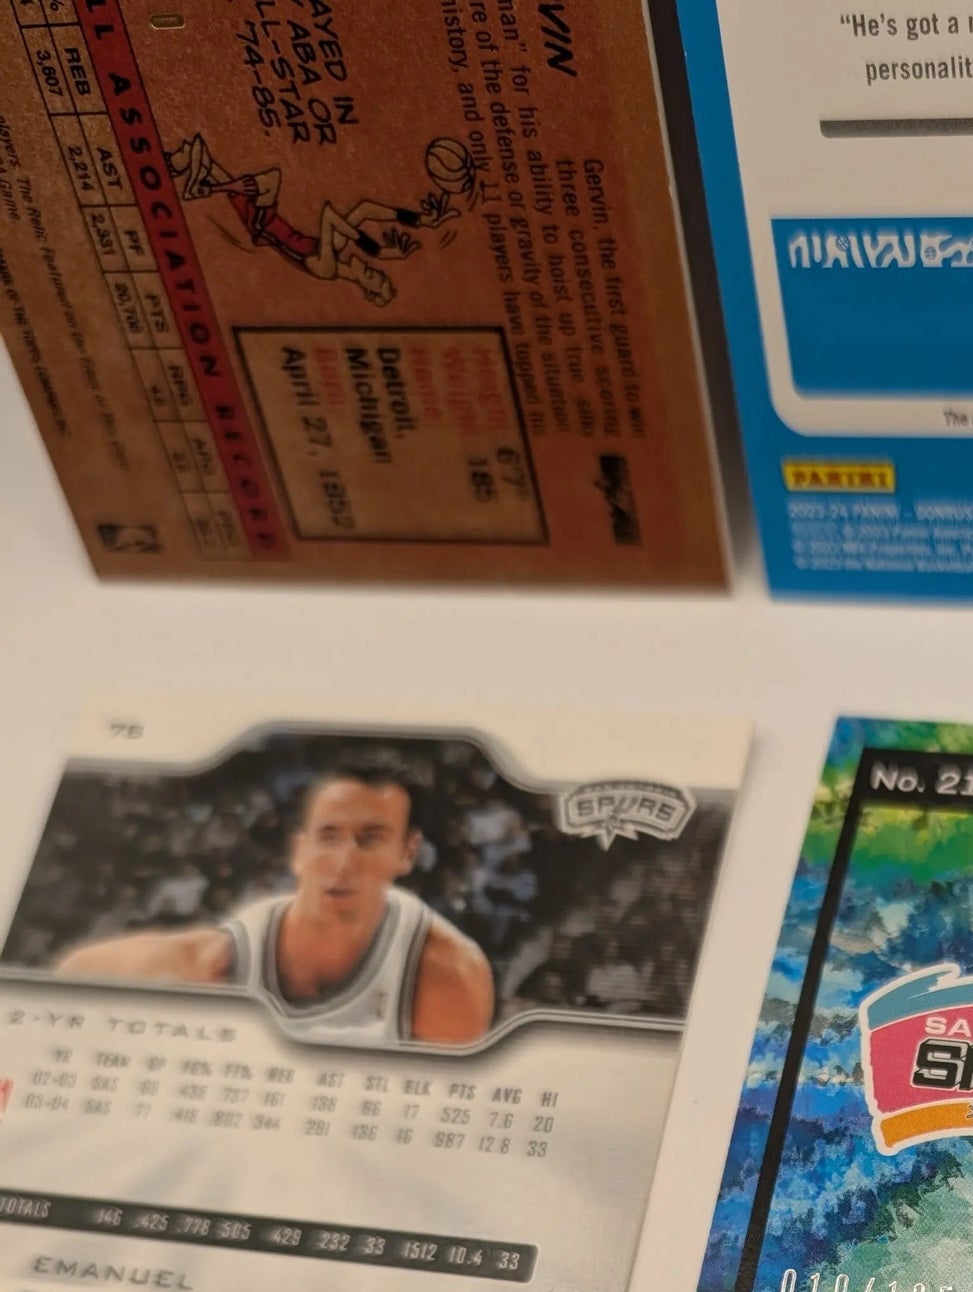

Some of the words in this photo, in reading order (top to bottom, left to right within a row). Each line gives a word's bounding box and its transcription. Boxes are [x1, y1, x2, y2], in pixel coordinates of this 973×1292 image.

[906, 13, 940, 41] got
[948, 16, 959, 35] a
[63, 47, 91, 97] REB
[287, 20, 322, 85] ABA
[308, 98, 338, 146] OR
[489, 101, 520, 185] defense
[510, 65, 530, 95] for
[526, 150, 553, 216] ability
[97, 147, 123, 191] AST
[555, 158, 580, 216] three
[584, 158, 609, 231] Gervin,
[108, 73, 222, 376] ASSOCIATION
[944, 411, 969, 428] The
[791, 469, 889, 488] PANINI
[870, 763, 926, 793] No.
[33, 1256, 195, 1291] EMANUEL
[403, 1241, 438, 1261] 1512
[449, 1245, 483, 1266] 10.4
[499, 1252, 520, 1270] 33
